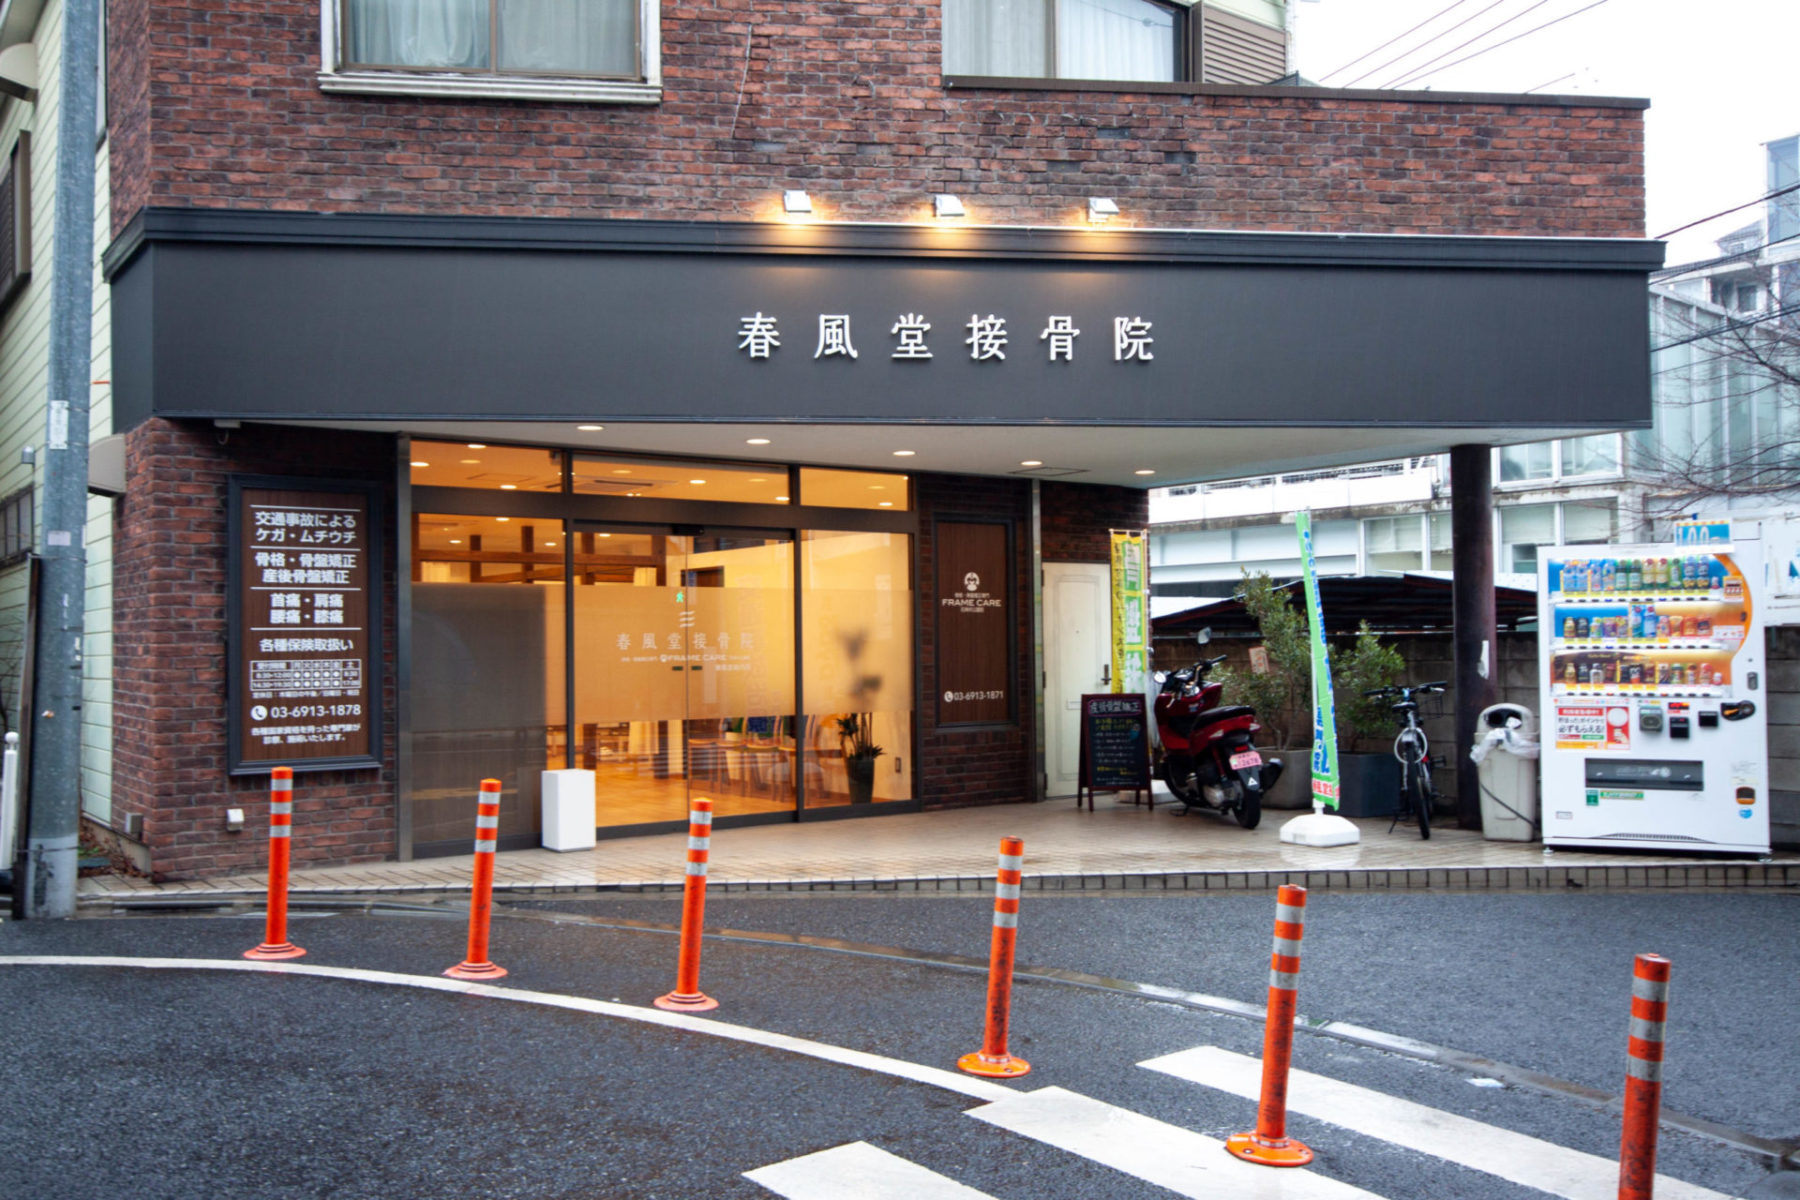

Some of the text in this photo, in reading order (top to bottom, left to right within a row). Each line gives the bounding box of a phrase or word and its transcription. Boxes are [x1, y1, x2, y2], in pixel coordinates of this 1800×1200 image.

[738, 312, 1155, 361] 春風堂接骨院
[255, 511, 356, 528] 交通事故による
[255, 528, 357, 544] ケガ・ムチウチ
[942, 599, 1002, 607] FRAME CARE
[616, 632, 754, 650] 春風堂接骨院
[953, 691, 1004, 700] 03-6913-1871
[270, 704, 361, 718] 03-6913-1878
